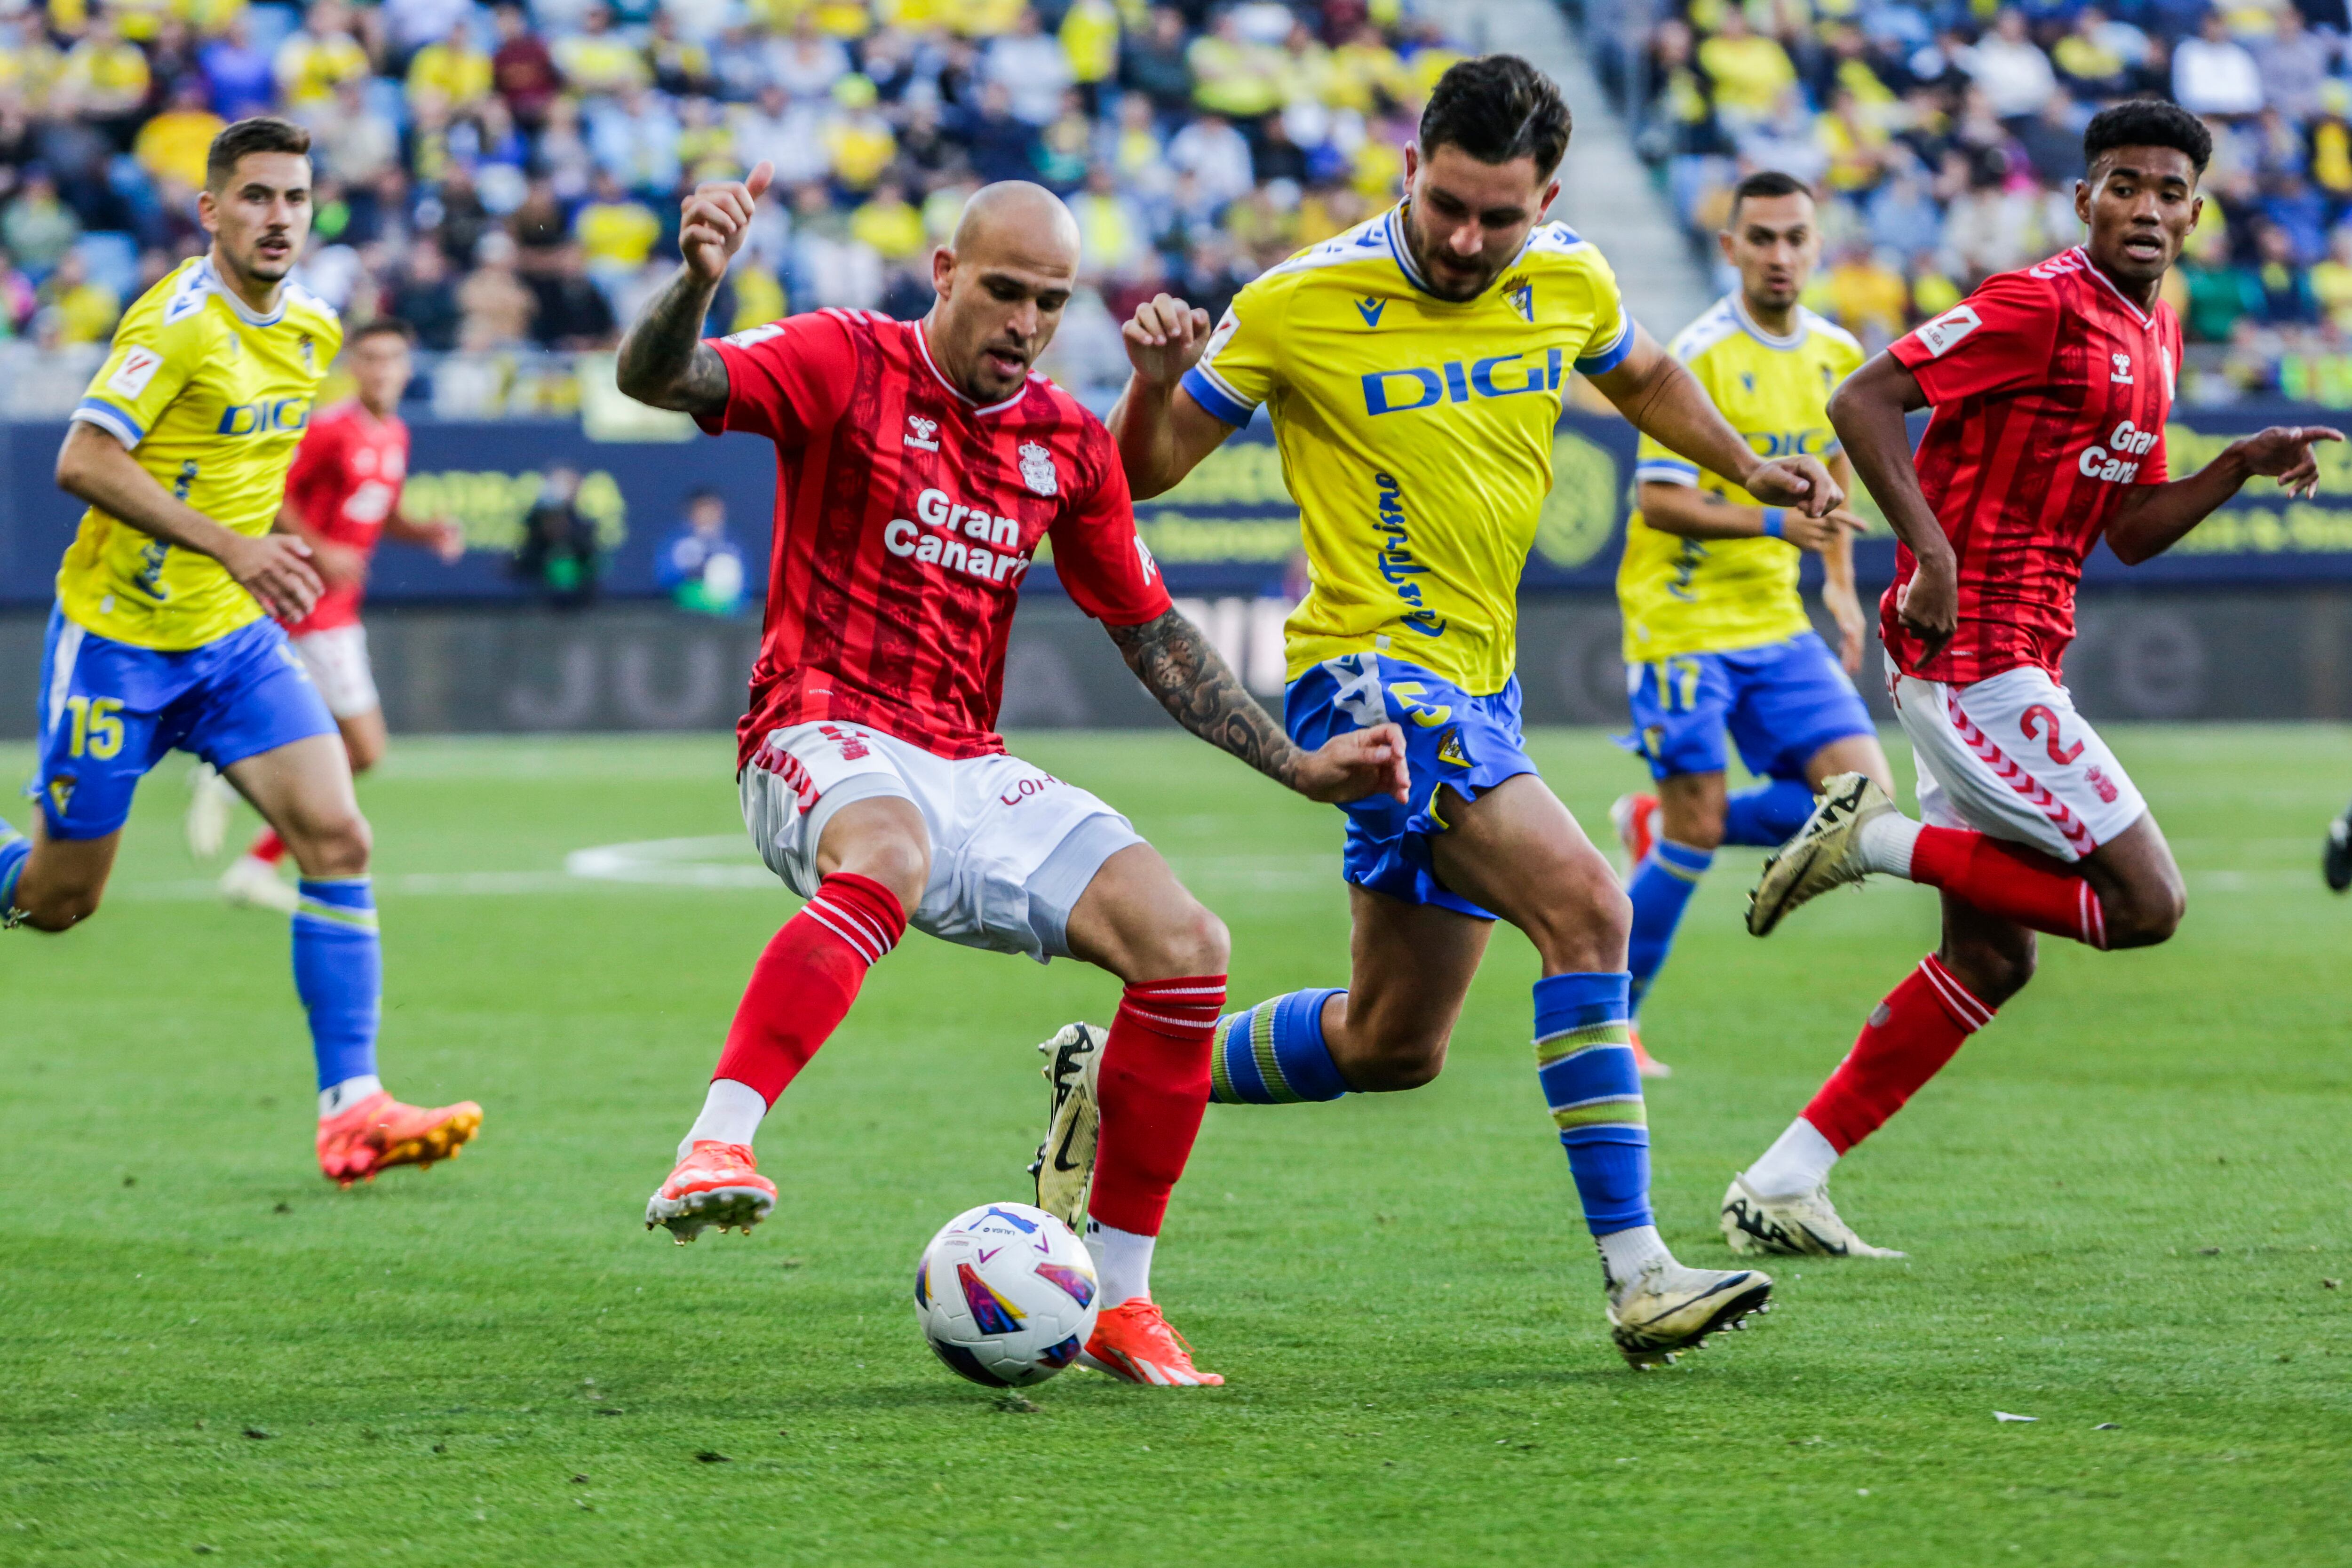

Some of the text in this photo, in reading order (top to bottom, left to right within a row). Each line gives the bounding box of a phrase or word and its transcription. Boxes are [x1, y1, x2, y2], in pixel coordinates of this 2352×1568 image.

[1362, 349, 1563, 416] DIGI
[903, 433, 939, 452] hummel
[917, 488, 1019, 548] Gran
[1654, 660, 1701, 711] 17
[67, 695, 125, 761] 15
[2020, 704, 2084, 765] 2
[992, 1226, 1015, 1236] LALIGA
